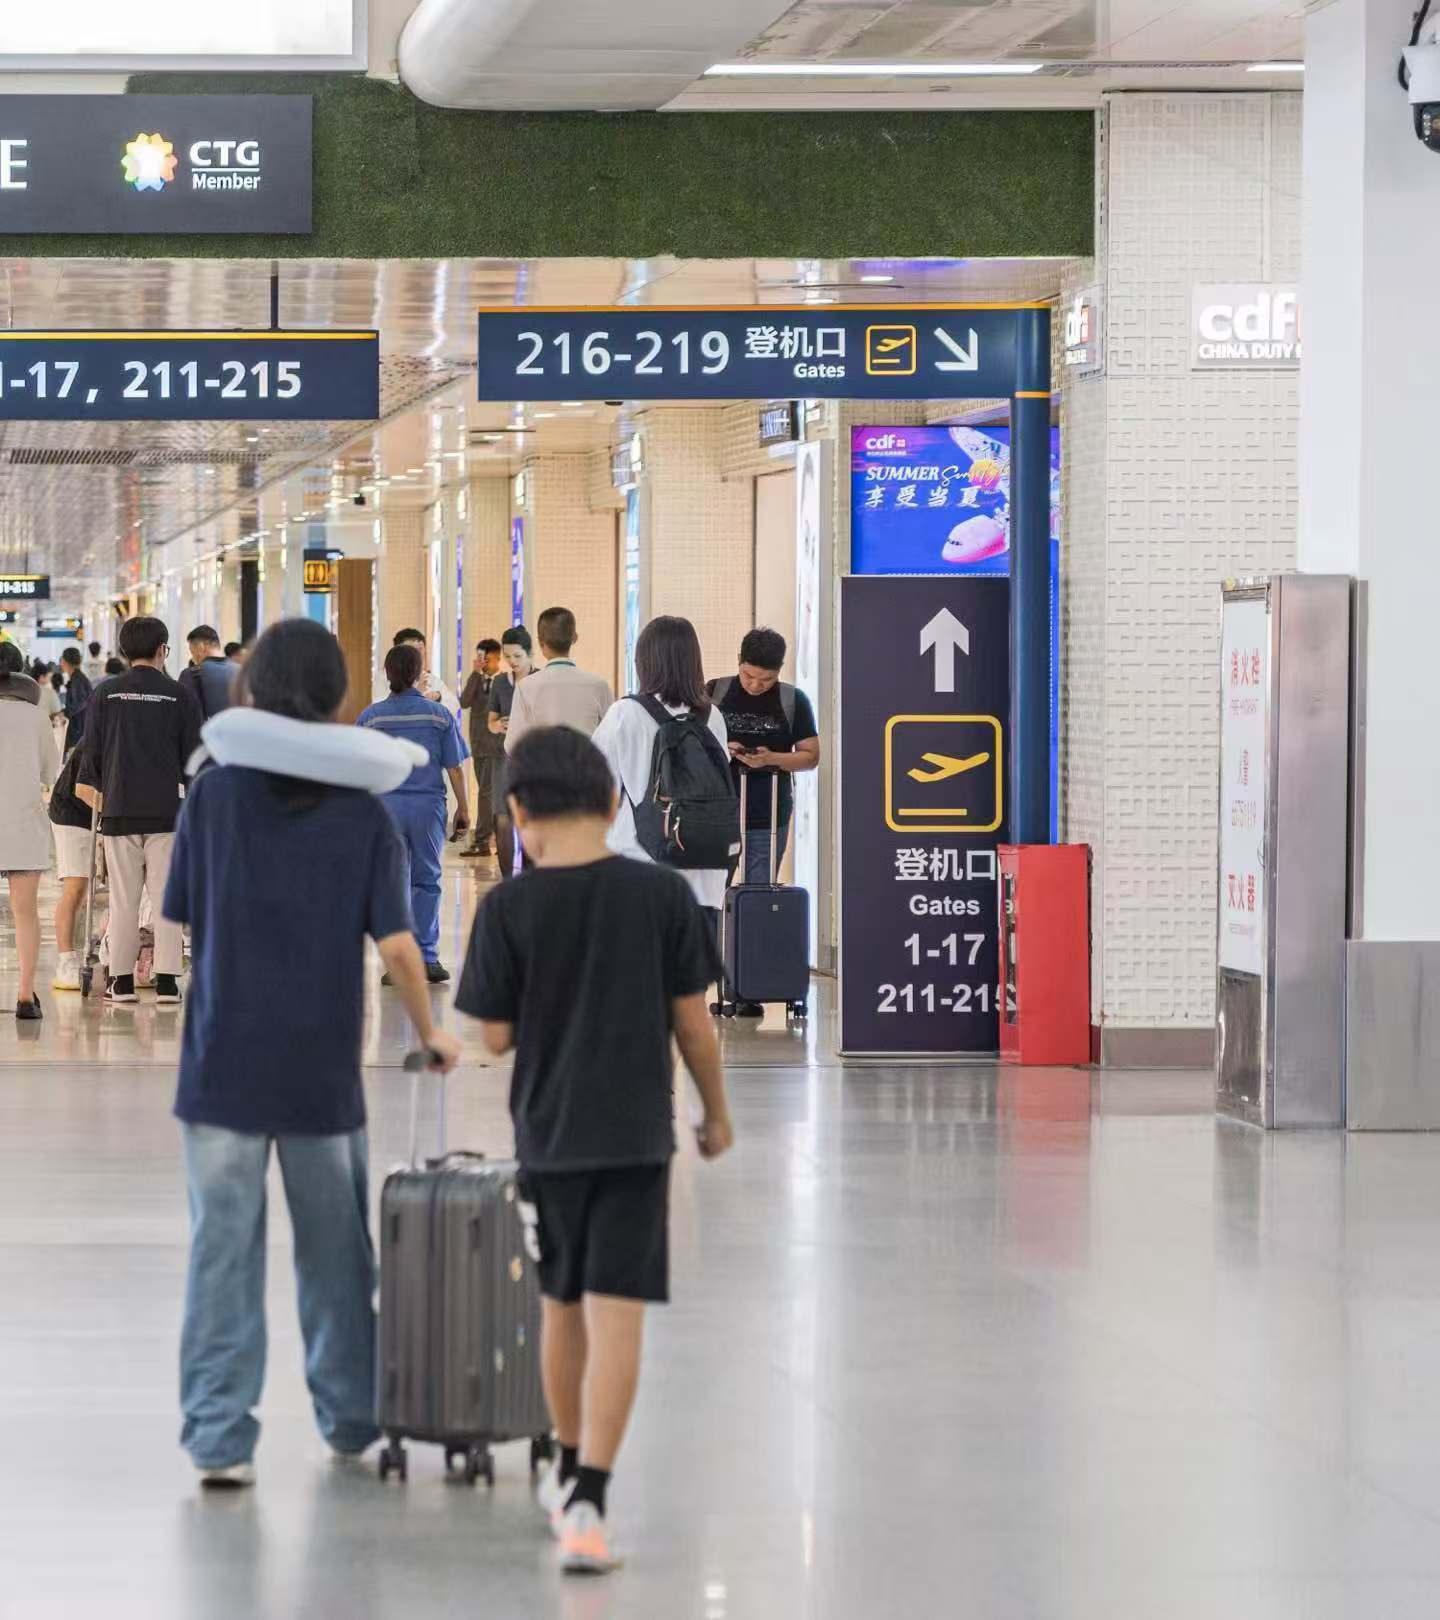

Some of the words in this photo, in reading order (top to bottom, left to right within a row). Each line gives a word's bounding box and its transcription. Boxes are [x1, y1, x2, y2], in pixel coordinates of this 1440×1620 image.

[189, 140, 261, 166] CTG
[191, 171, 261, 190] Member
[1199, 292, 1296, 341] cdf
[515, 331, 730, 375] 216-219
[744, 326, 846, 359] 登机口
[1199, 344, 1249, 359] CHINA
[1251, 344, 1295, 359] DUTY
[123, 361, 302, 398] 211-215
[794, 363, 846, 378] Gates
[866, 435, 895, 449] cdf
[865, 466, 939, 481] SUMMER
[864, 484, 984, 508] 享受当夏
[895, 848, 997, 881] 登机口
[909, 895, 980, 915] Gates
[904, 933, 986, 965] 1-17
[877, 984, 1001, 1013] 211-21
